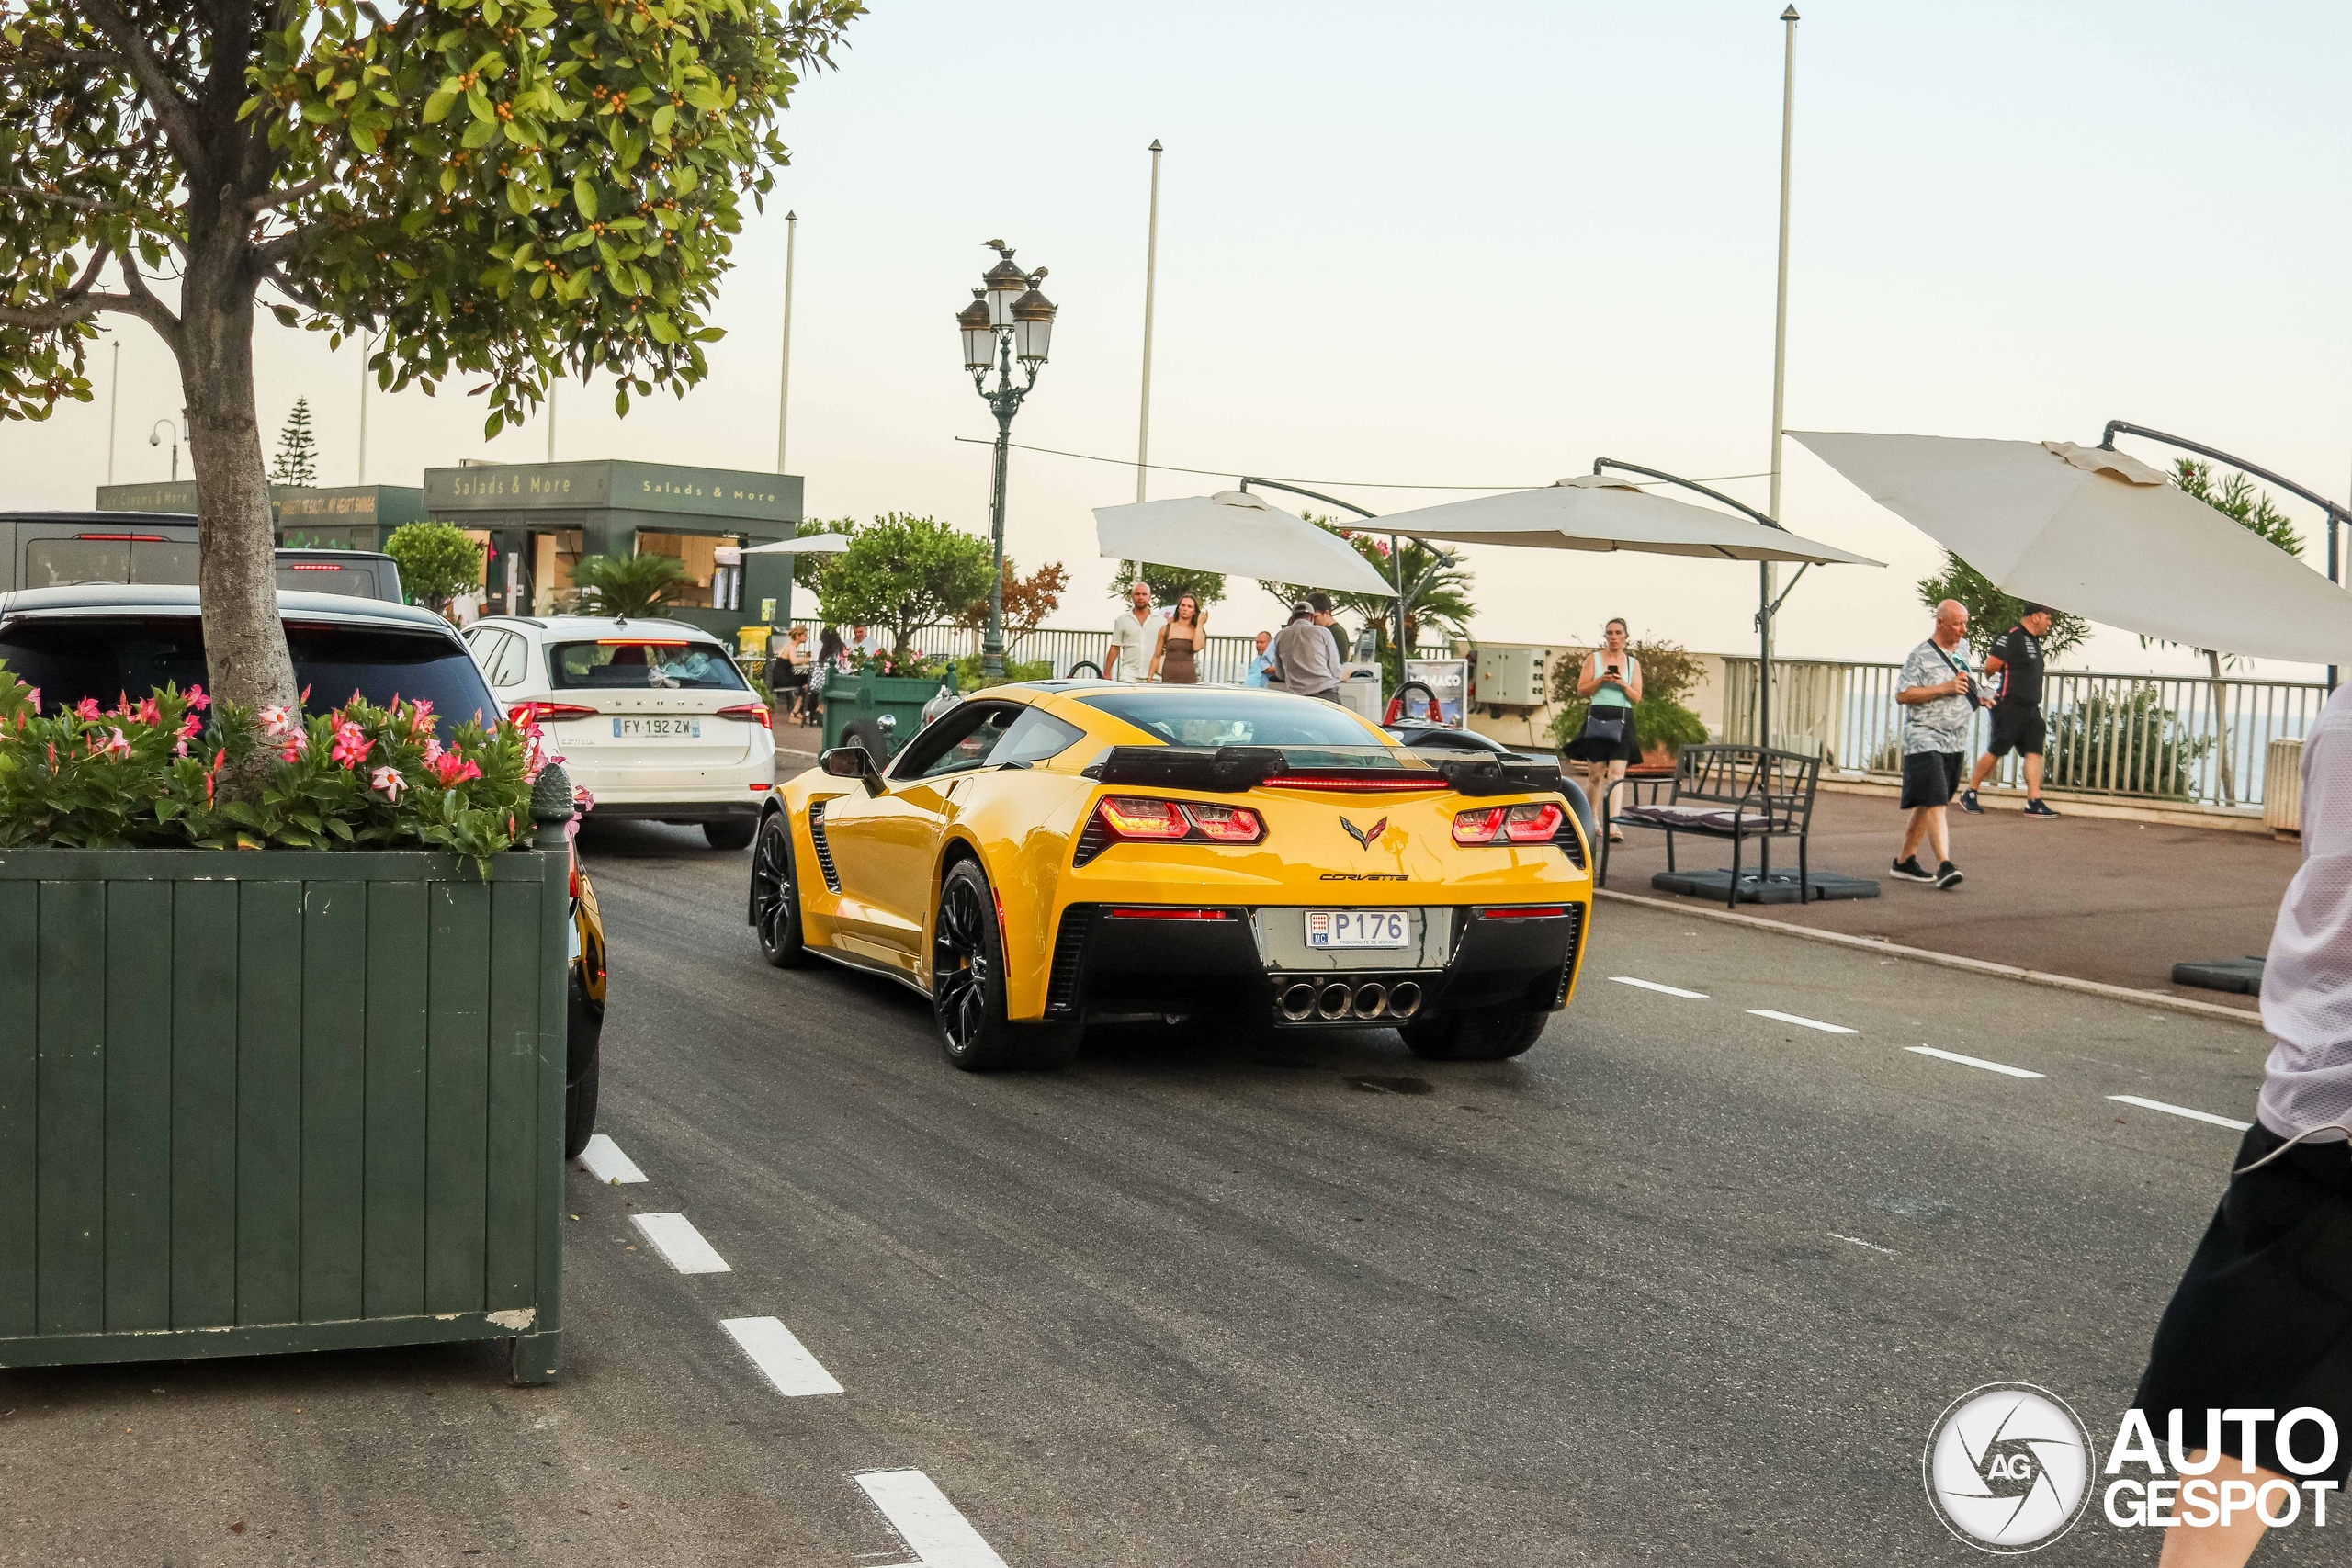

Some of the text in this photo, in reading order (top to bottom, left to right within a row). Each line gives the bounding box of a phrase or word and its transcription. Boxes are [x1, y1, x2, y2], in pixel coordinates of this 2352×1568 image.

[454, 475, 570, 495] Salads & More
[643, 480, 775, 502] Salads & More
[1335, 914, 1402, 939] P176
[1315, 934, 1326, 942] MC
